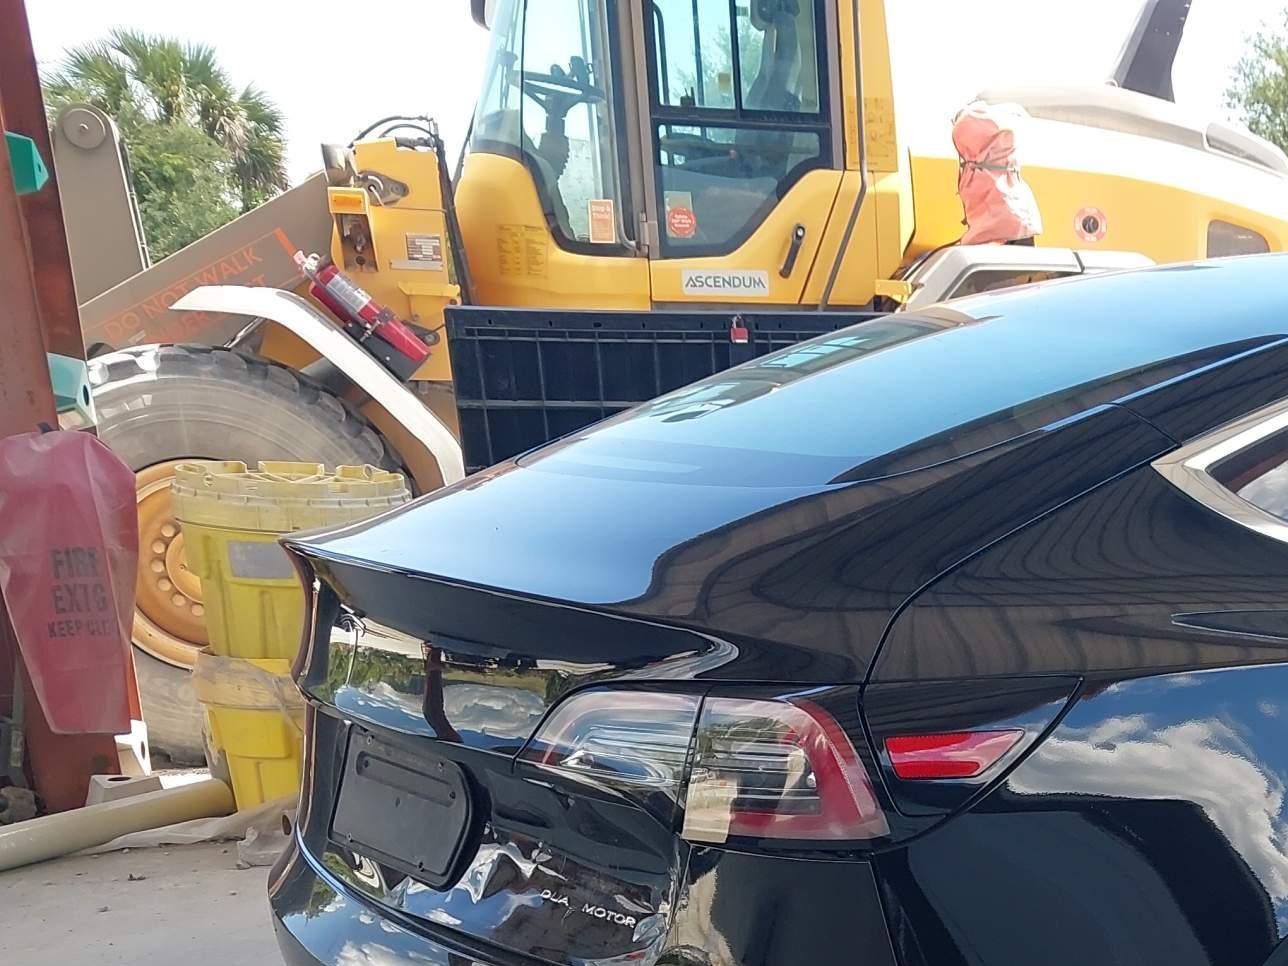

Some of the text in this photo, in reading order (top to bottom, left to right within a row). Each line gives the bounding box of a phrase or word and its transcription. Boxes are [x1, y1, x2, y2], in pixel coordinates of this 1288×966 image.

[685, 275, 766, 289] ASCENDUM
[104, 312, 140, 343] DO
[194, 248, 263, 288] WALK
[581, 903, 637, 928] MOTOR
